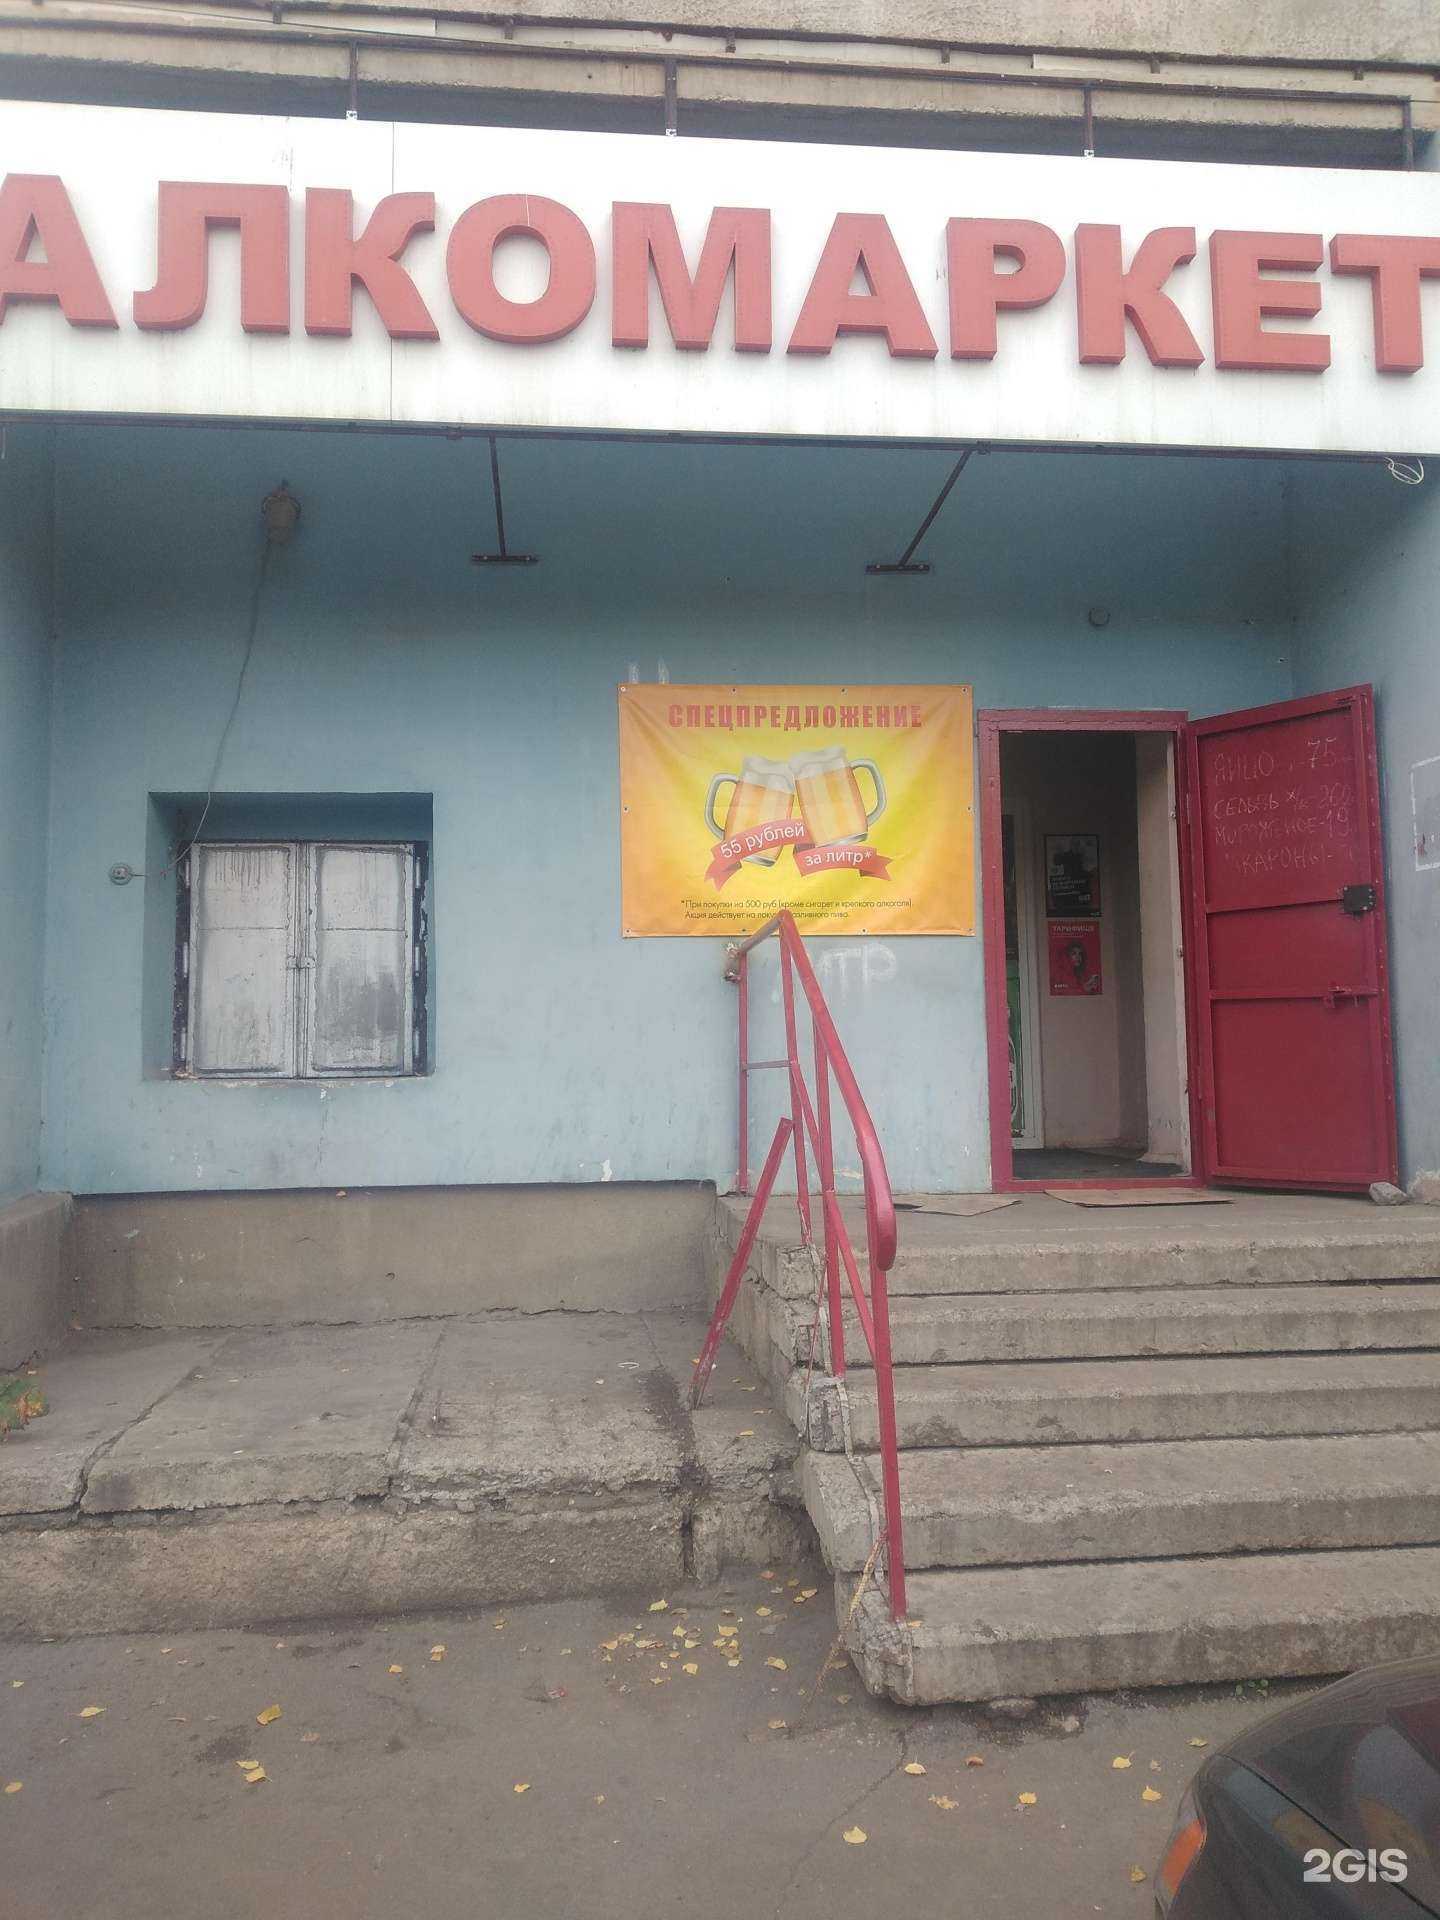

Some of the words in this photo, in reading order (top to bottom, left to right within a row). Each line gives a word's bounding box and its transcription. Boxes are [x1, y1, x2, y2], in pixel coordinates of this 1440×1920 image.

[0, 172, 1440, 376] АЛКОМАРКЕТ
[668, 703, 922, 731] СПЕЦПРЕДЛОЖЕНИЕ
[720, 839, 742, 858] 55
[744, 823, 805, 851] рублей
[804, 854, 822, 867] за
[745, 900, 761, 908] 500
[685, 911, 706, 920] Акция
[708, 911, 745, 920] действует
